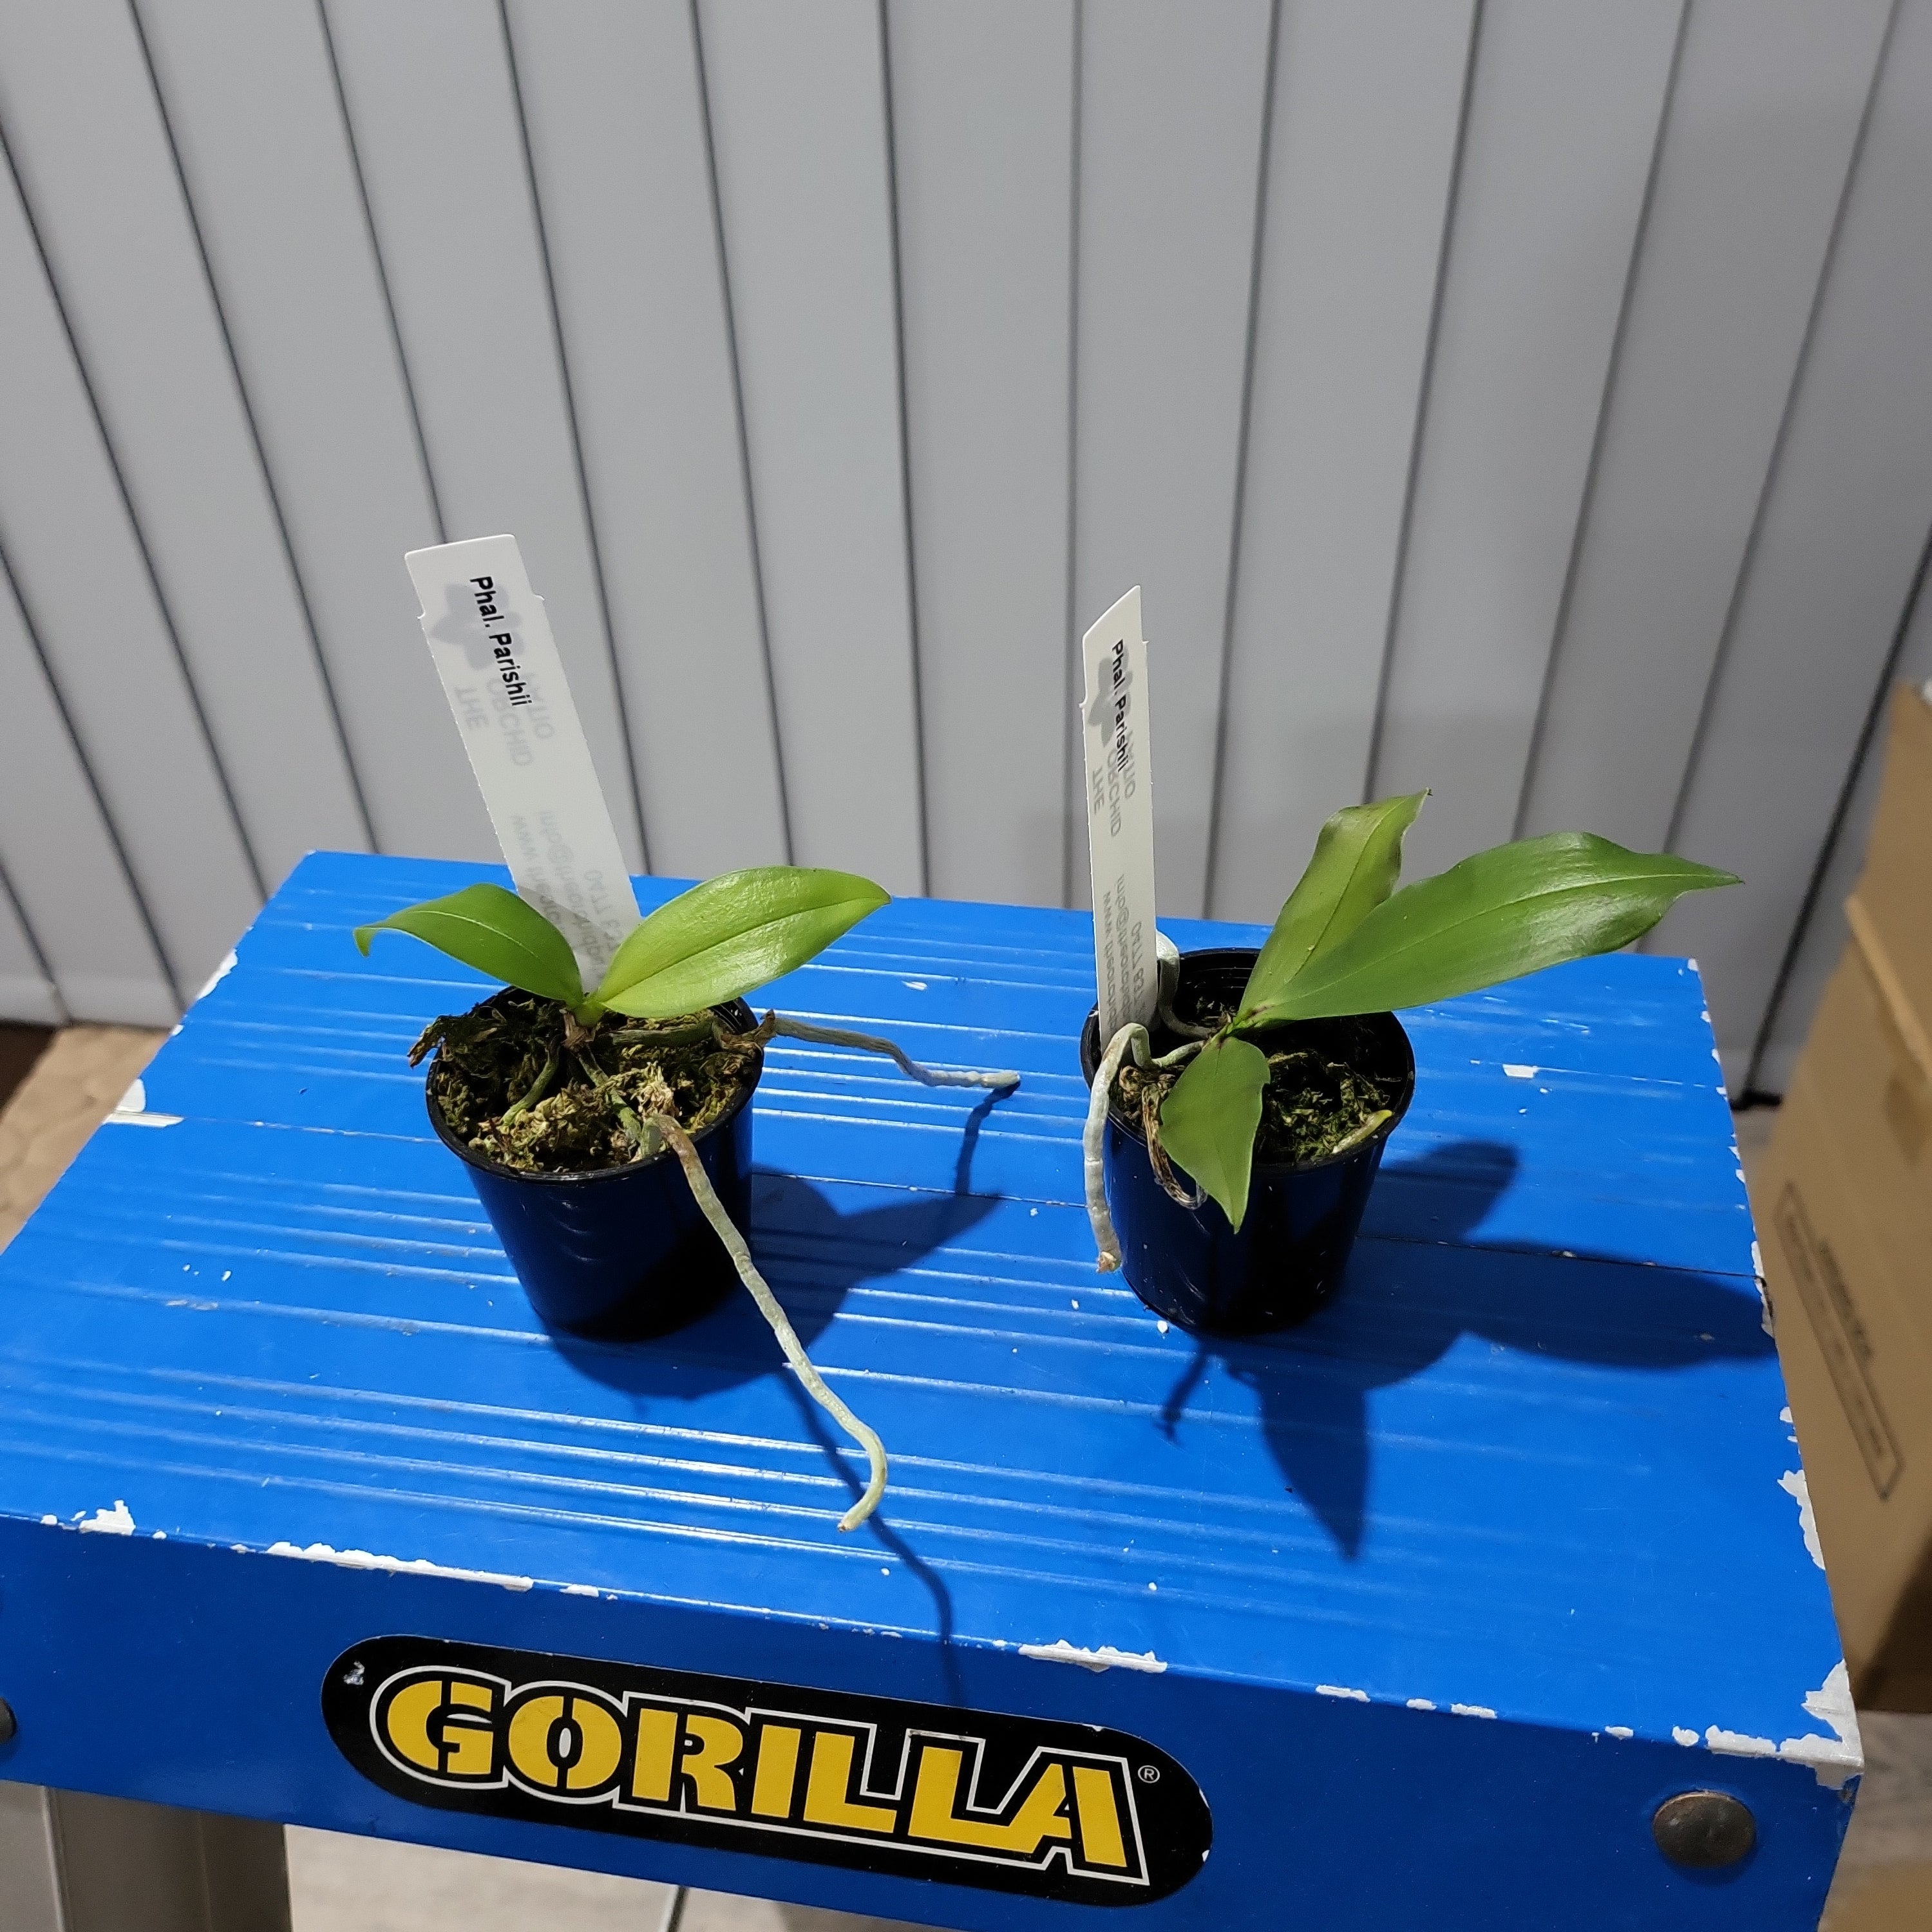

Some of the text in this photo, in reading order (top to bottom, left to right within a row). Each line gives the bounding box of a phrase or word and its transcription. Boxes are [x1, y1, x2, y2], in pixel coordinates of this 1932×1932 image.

[469, 576, 533, 706] Phal. Parishii
[1112, 639, 1129, 772] Phal. Parishii
[370, 1665, 1150, 1885] GORILLA
